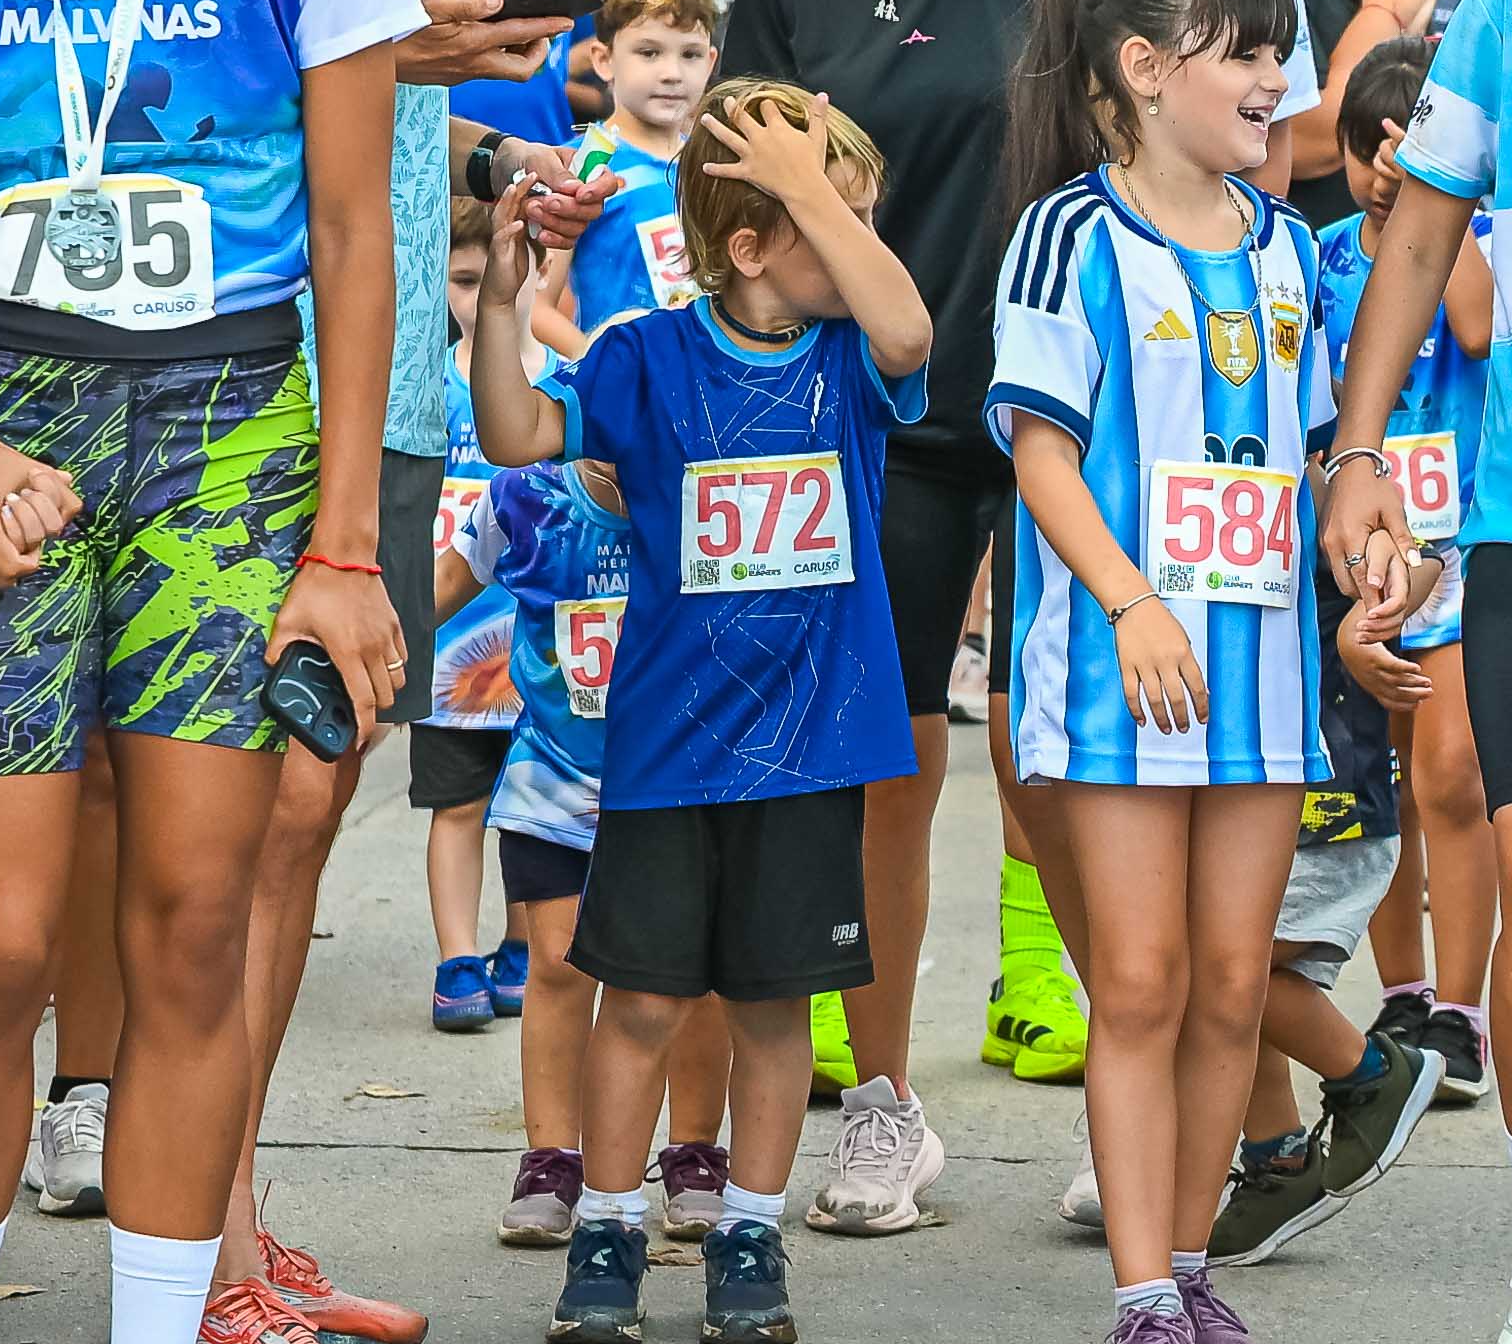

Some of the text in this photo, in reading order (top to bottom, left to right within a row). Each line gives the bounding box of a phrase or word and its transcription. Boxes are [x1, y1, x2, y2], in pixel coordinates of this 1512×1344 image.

[649, 226, 692, 284] 5
[133, 300, 196, 315] CARUSO
[697, 467, 837, 558] 572
[1164, 475, 1293, 572] 584
[1410, 518, 1452, 531] CARUSO
[793, 561, 839, 575] CARUSO
[569, 611, 623, 688] 5
